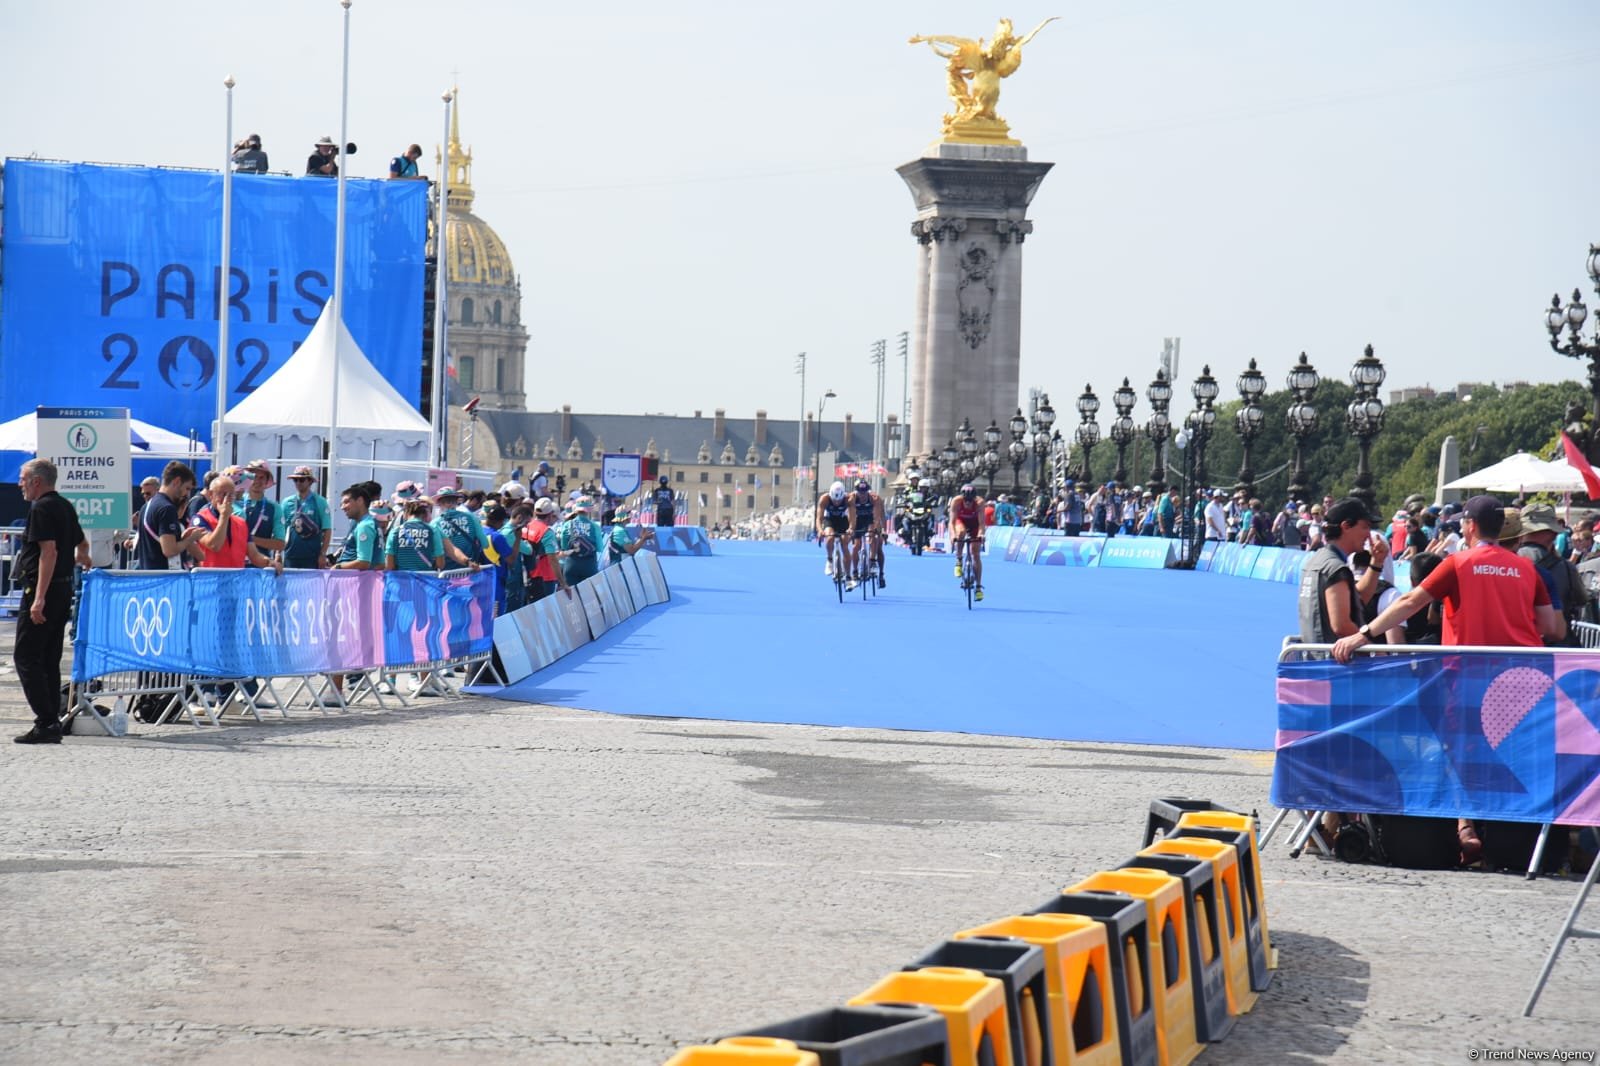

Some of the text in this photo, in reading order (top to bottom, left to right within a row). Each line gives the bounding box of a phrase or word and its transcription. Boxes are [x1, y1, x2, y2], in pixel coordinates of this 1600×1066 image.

[100, 332, 301, 394] 202
[66, 470, 99, 481] AREA
[68, 498, 115, 516] ART
[1473, 565, 1521, 578] MEDICAL
